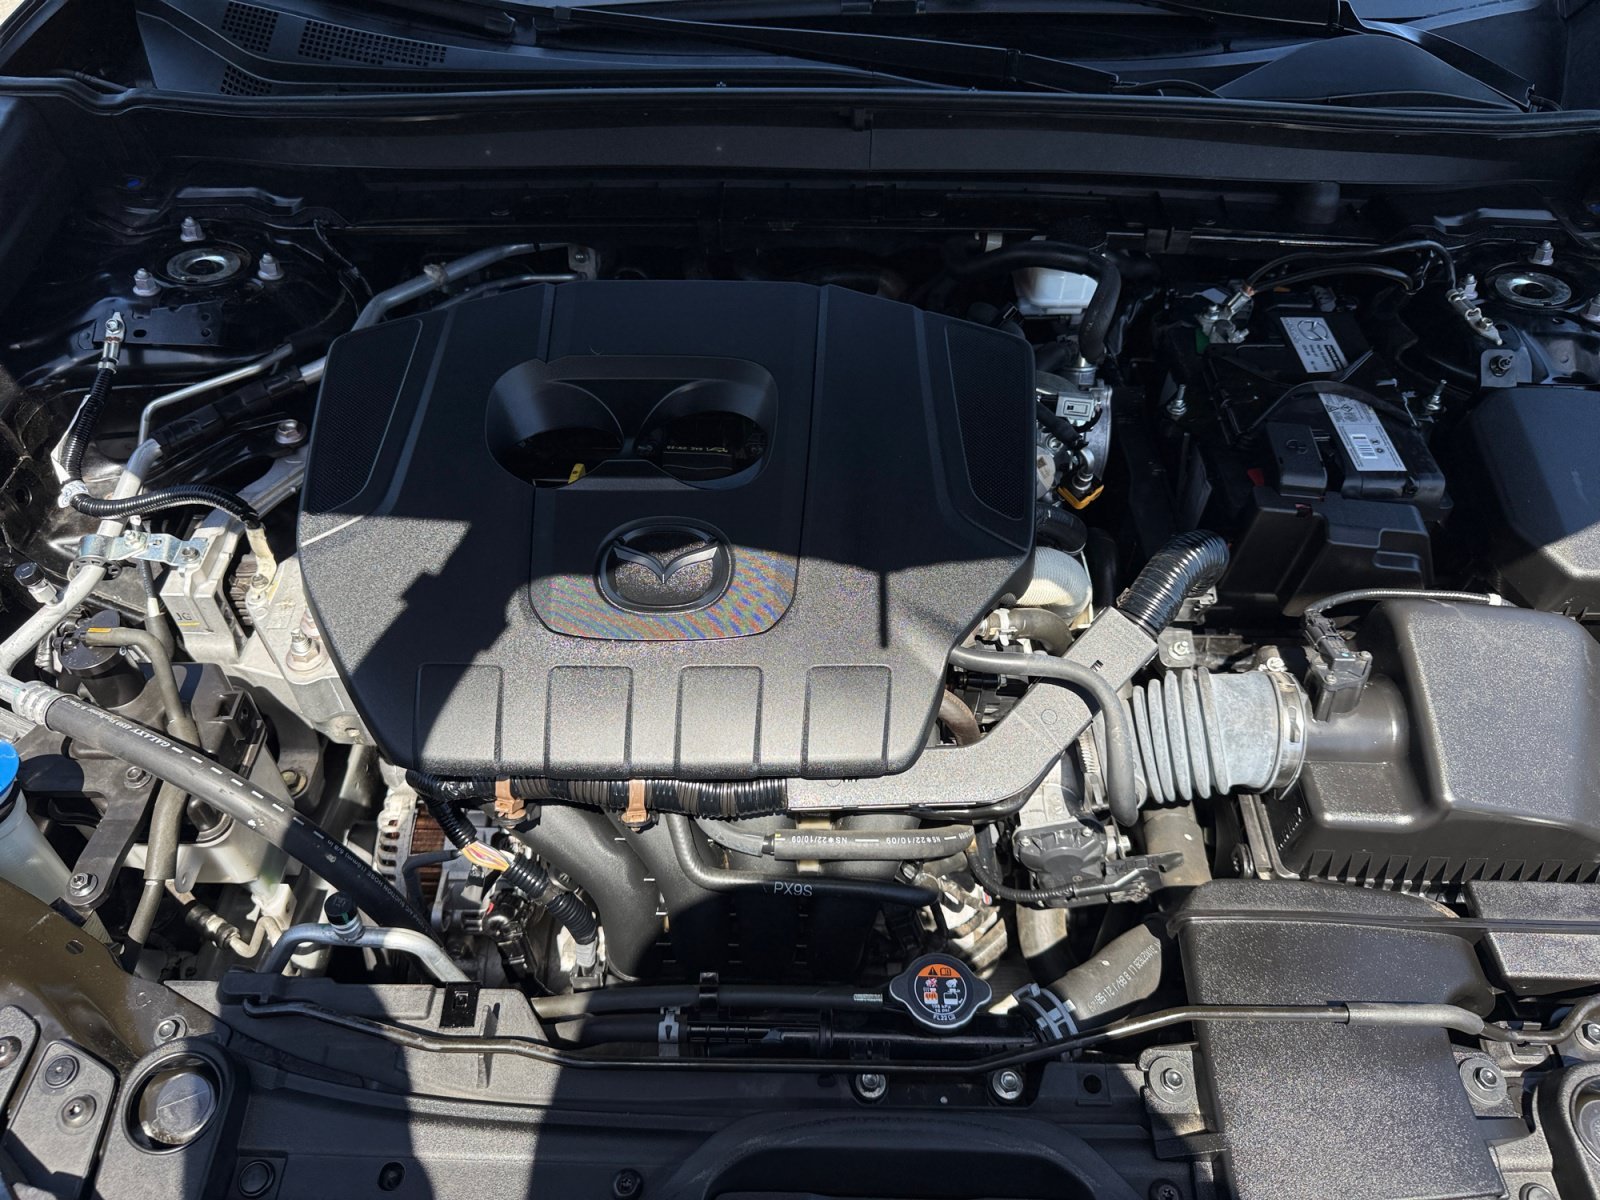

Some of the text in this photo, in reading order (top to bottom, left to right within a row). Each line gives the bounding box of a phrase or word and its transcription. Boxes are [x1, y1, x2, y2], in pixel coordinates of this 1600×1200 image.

[130, 728, 170, 747] GALAXY
[367, 871, 383, 887] HOSE
[773, 881, 812, 896] PX9S
